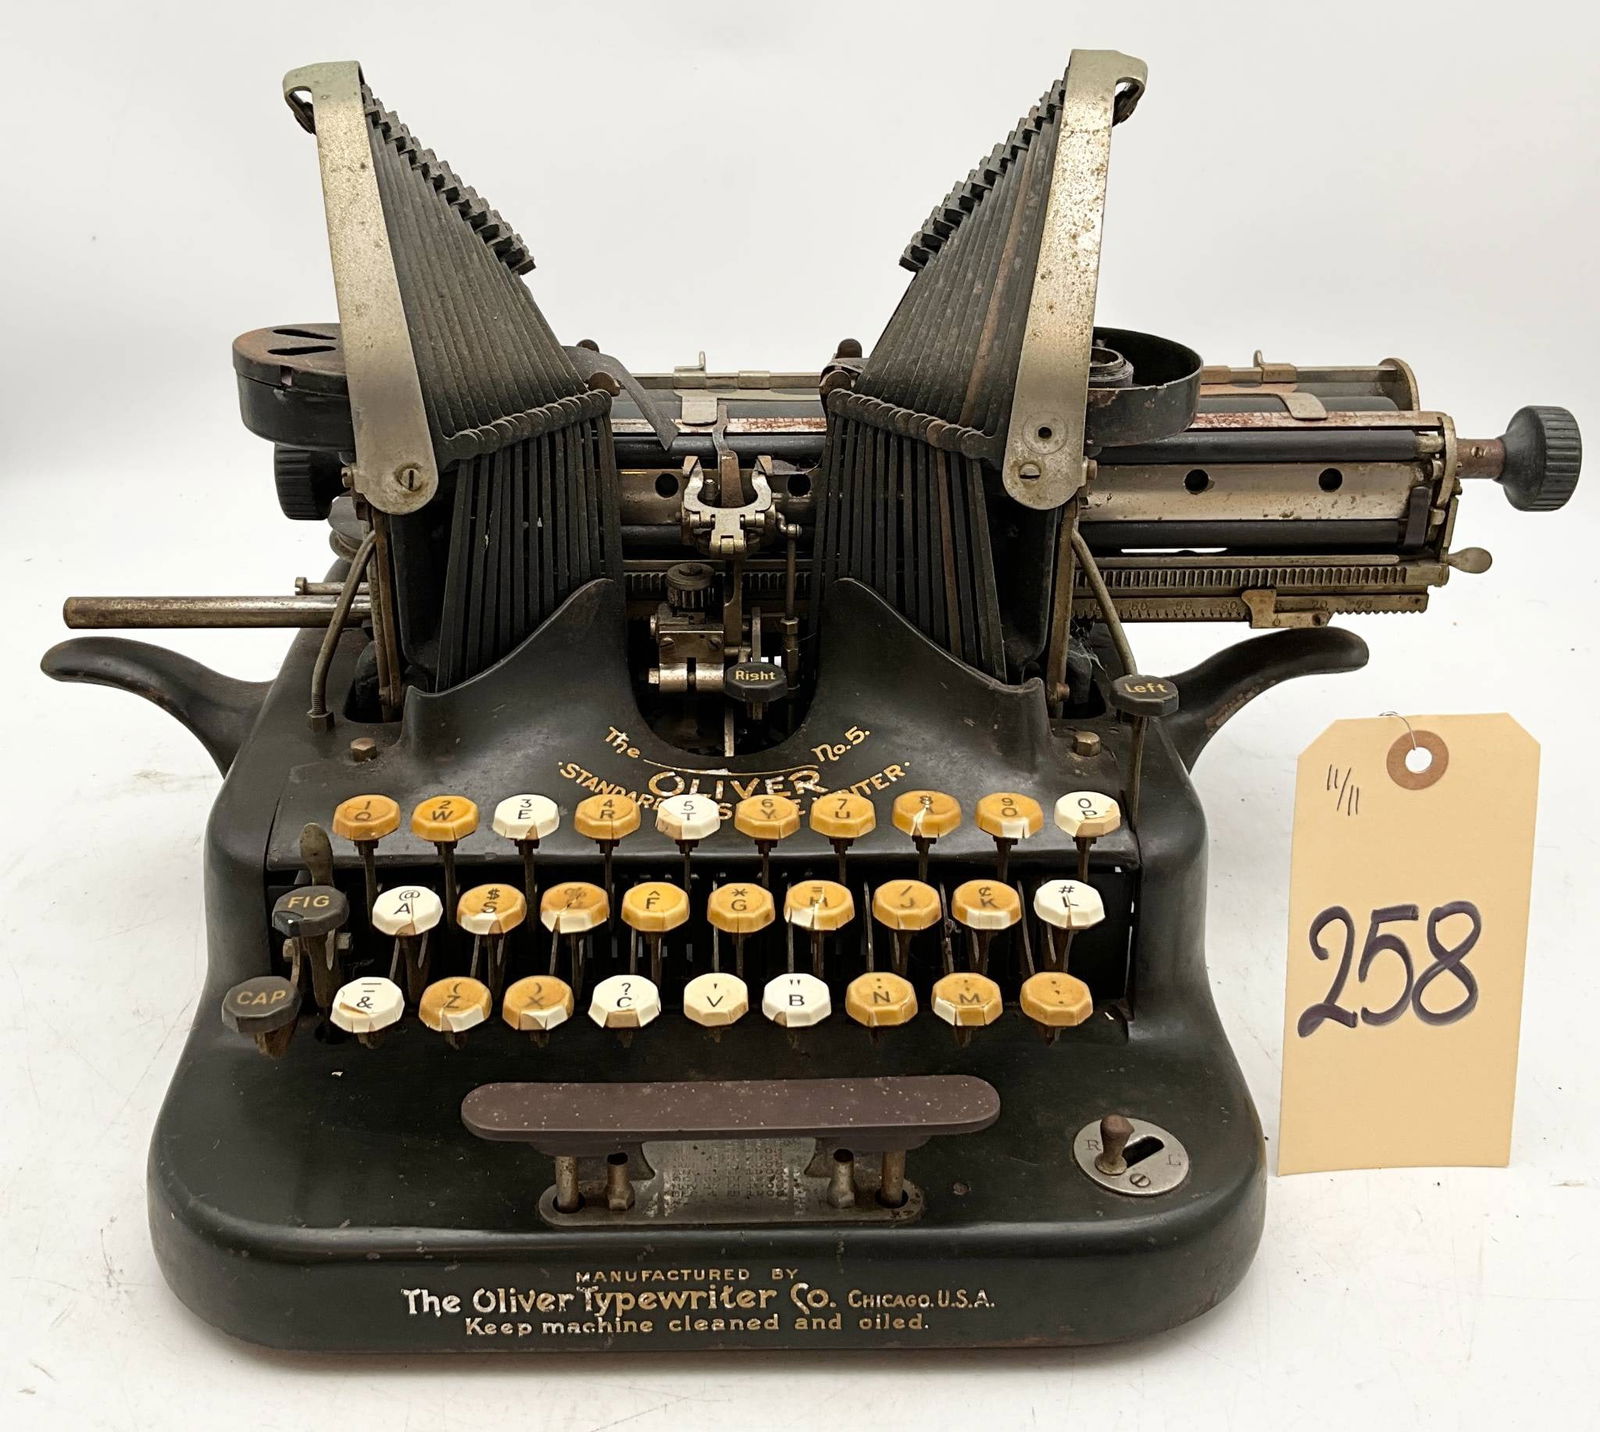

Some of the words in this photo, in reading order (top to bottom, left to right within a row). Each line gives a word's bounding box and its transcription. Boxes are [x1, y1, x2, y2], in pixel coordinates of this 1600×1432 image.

[735, 670, 776, 681] Right
[1124, 683, 1168, 693] Left
[605, 726, 641, 758] The
[648, 770, 829, 800] OLIVER
[1326, 764, 1360, 816] 11/11
[439, 801, 451, 809] 2
[520, 799, 532, 808] 3
[603, 800, 615, 808] 4
[683, 801, 694, 811] 5
[761, 799, 774, 808] 6
[838, 799, 848, 810] 7
[1001, 797, 1014, 806] 9
[431, 811, 453, 821] W
[517, 809, 533, 819] E
[600, 809, 614, 820] R
[681, 812, 697, 821] T
[761, 809, 775, 820] Y
[835, 811, 850, 819] U
[486, 887, 500, 901] $
[1058, 885, 1075, 894] #
[398, 890, 421, 901] @
[288, 896, 330, 909] FIG
[480, 901, 499, 914] S
[646, 898, 660, 909] F
[730, 899, 747, 912] G
[980, 898, 999, 908] K
[393, 902, 412, 915] A
[1297, 900, 1482, 1038] 258
[621, 983, 632, 995] ?
[236, 989, 288, 1006] CAP
[356, 996, 374, 1009] &
[444, 995, 460, 1009] Z
[617, 997, 633, 1008] C
[707, 996, 724, 1008] V
[789, 995, 805, 1006] B
[873, 991, 890, 1004] N
[959, 993, 980, 1004] M
[1086, 1139, 1102, 1151] R
[1166, 1154, 1181, 1167] L
[576, 1268, 750, 1283] MANUFACTURED
[771, 1268, 799, 1281] BY
[400, 1288, 462, 1317] The
[472, 1287, 575, 1314] Oliver
[576, 1284, 778, 1317] Typewriter
[790, 1282, 837, 1315] Co.
[937, 1288, 996, 1309] U.S.A.
[465, 1317, 533, 1337] Keep
[541, 1313, 654, 1334] machine
[668, 1313, 780, 1333] cleaned
[794, 1312, 843, 1331] and
[858, 1312, 930, 1331] oiled.
